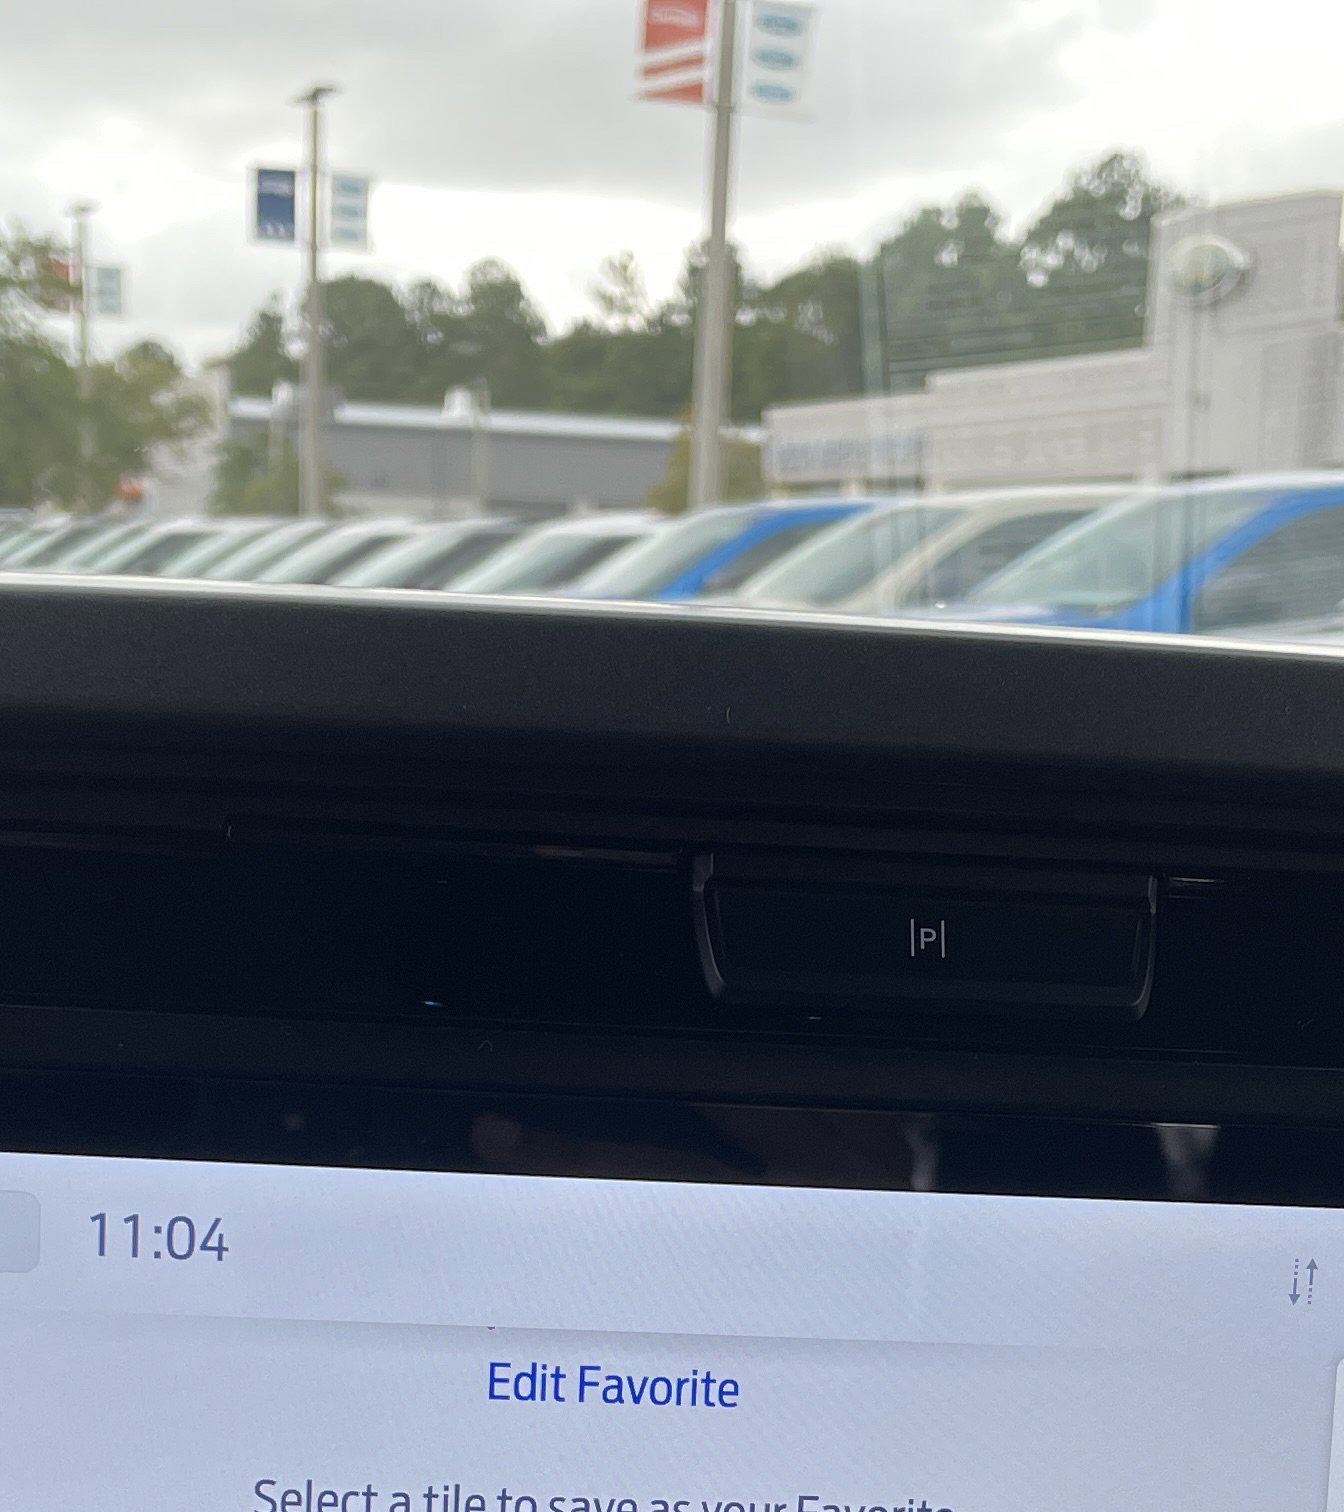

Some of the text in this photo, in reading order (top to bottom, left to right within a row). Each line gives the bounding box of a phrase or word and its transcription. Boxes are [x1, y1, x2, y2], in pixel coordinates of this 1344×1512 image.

[91, 1213, 228, 1261] 11:04
[489, 1362, 738, 1407] Edit Favorite
